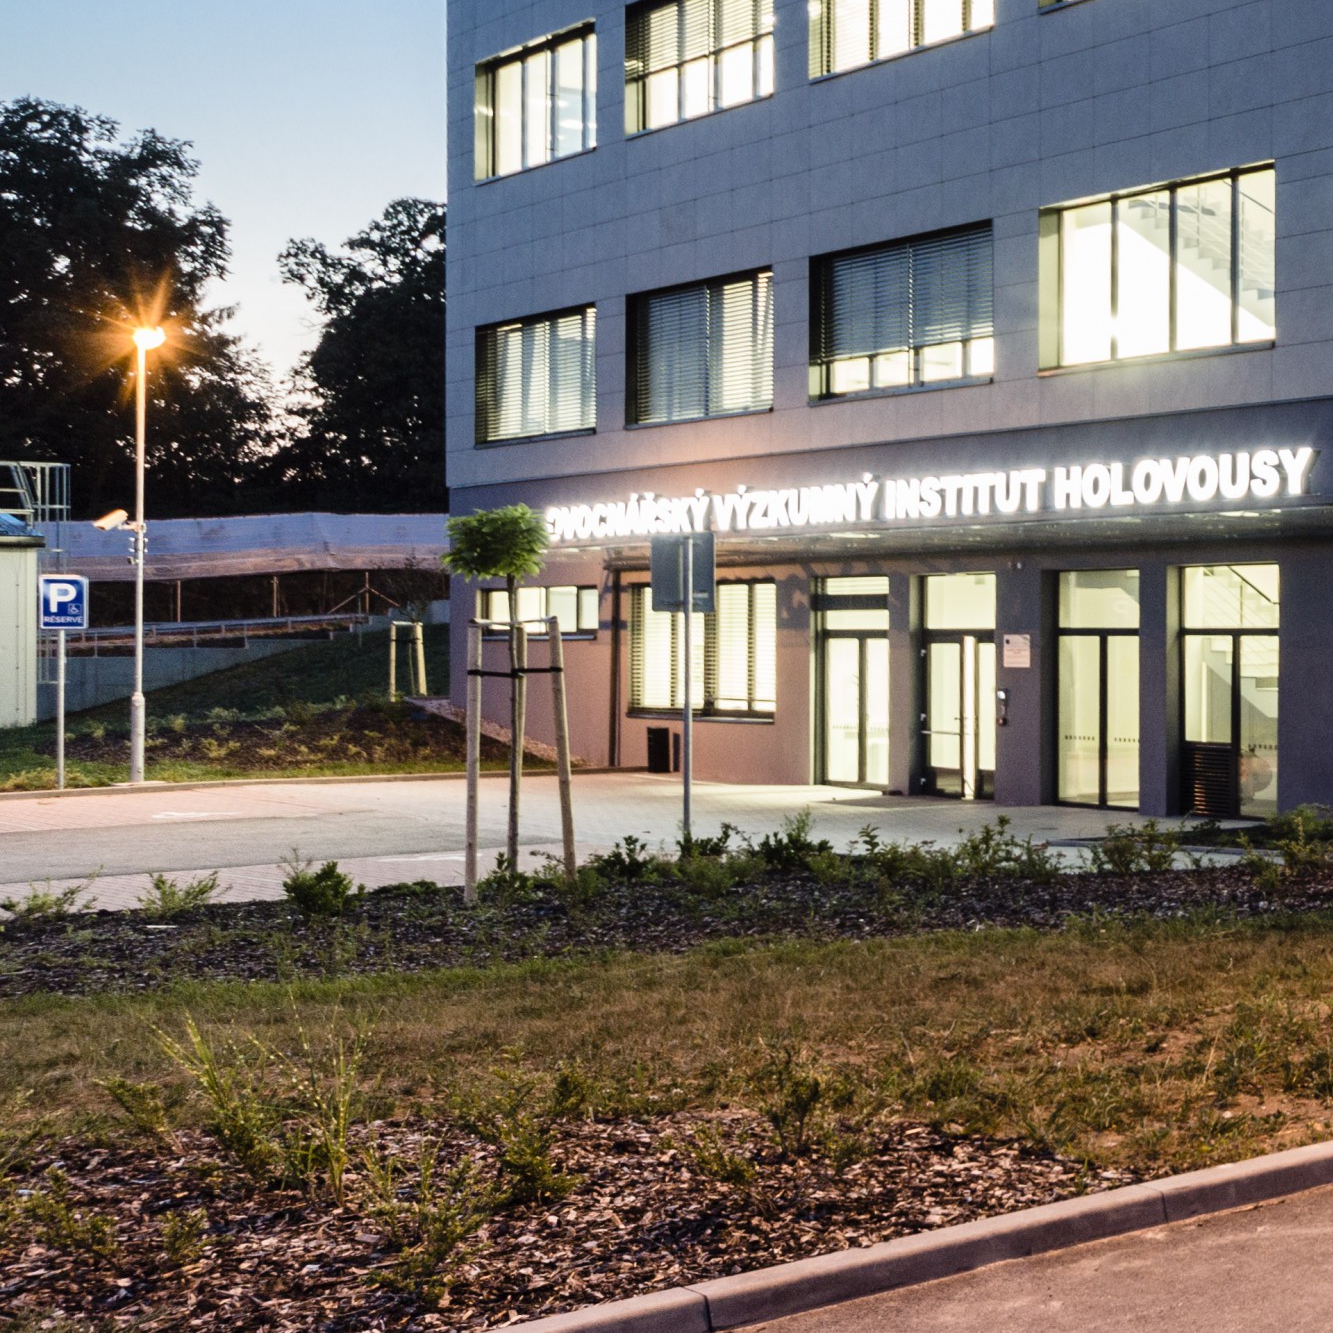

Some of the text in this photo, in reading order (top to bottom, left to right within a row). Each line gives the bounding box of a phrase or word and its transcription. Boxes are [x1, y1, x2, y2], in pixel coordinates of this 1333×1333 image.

[712, 471, 879, 531] VÝZKUMNÝ
[884, 468, 1046, 519] INSTITUT
[1054, 447, 1313, 509] HOLOVOUSY
[49, 582, 77, 613] P
